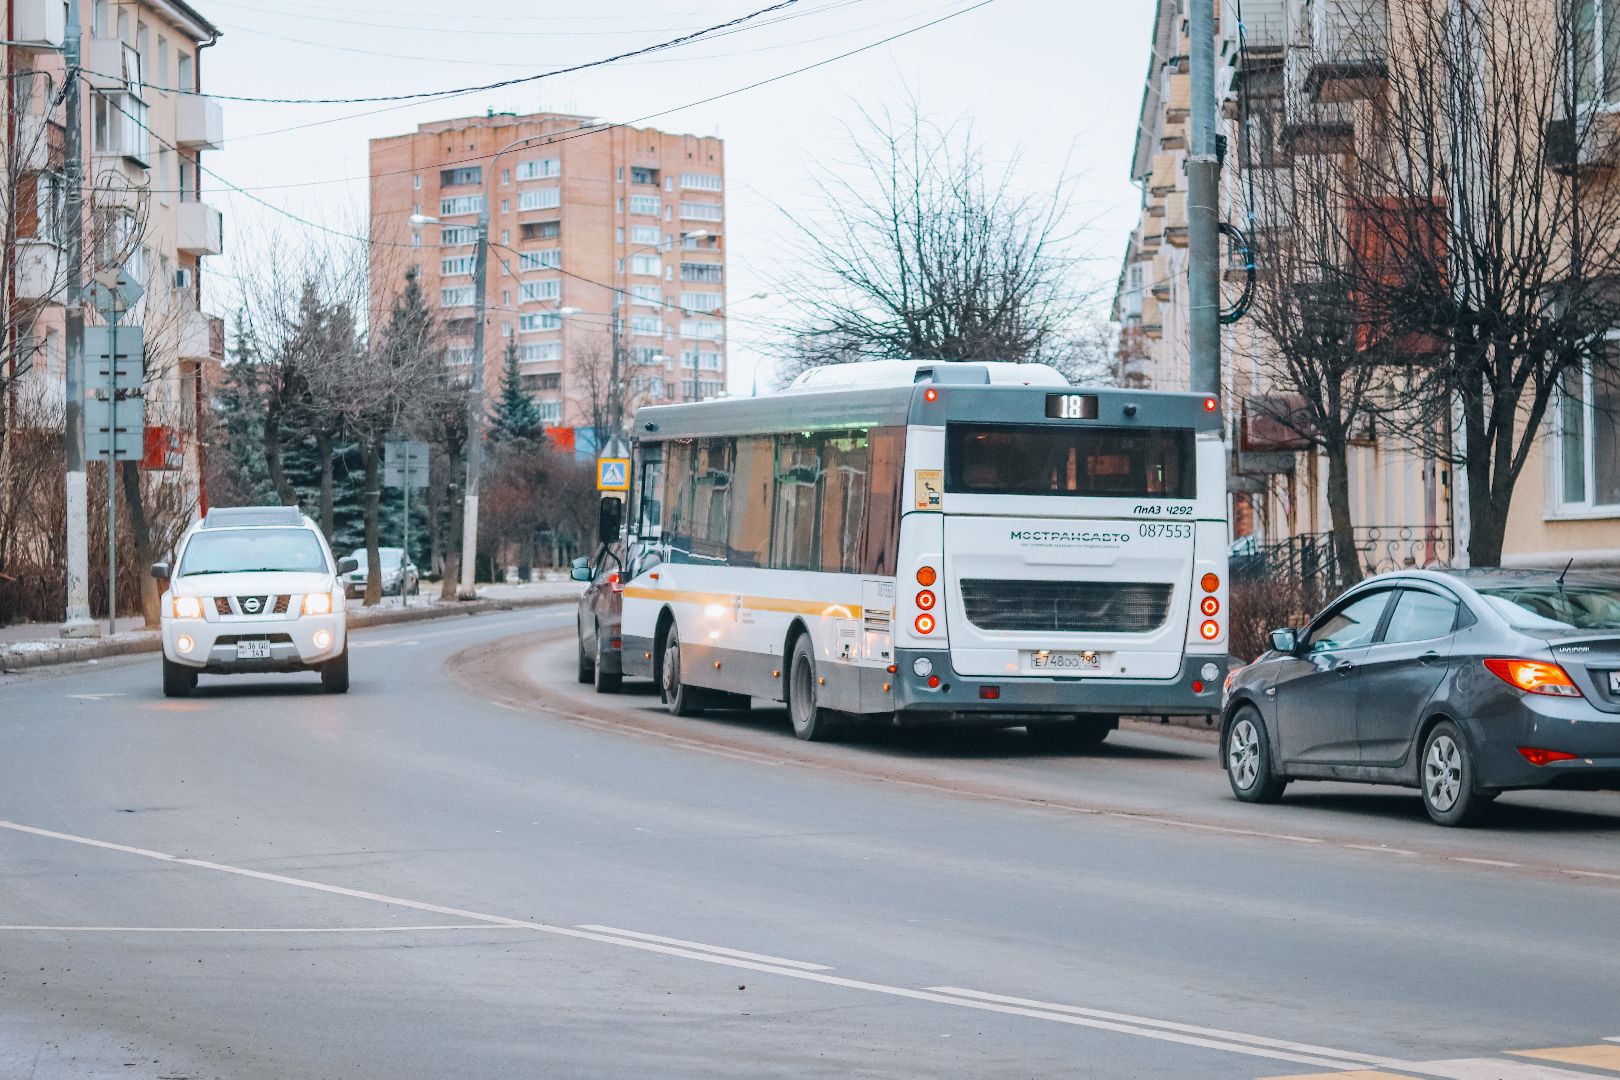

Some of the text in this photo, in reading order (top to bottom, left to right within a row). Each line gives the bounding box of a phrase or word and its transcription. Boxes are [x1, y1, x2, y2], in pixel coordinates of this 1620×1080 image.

[1061, 394, 1082, 418] 18
[1166, 506, 1193, 515] 4292
[1010, 531, 1130, 542] МОСТРАНСАВТО
[1139, 523, 1191, 539] 087553
